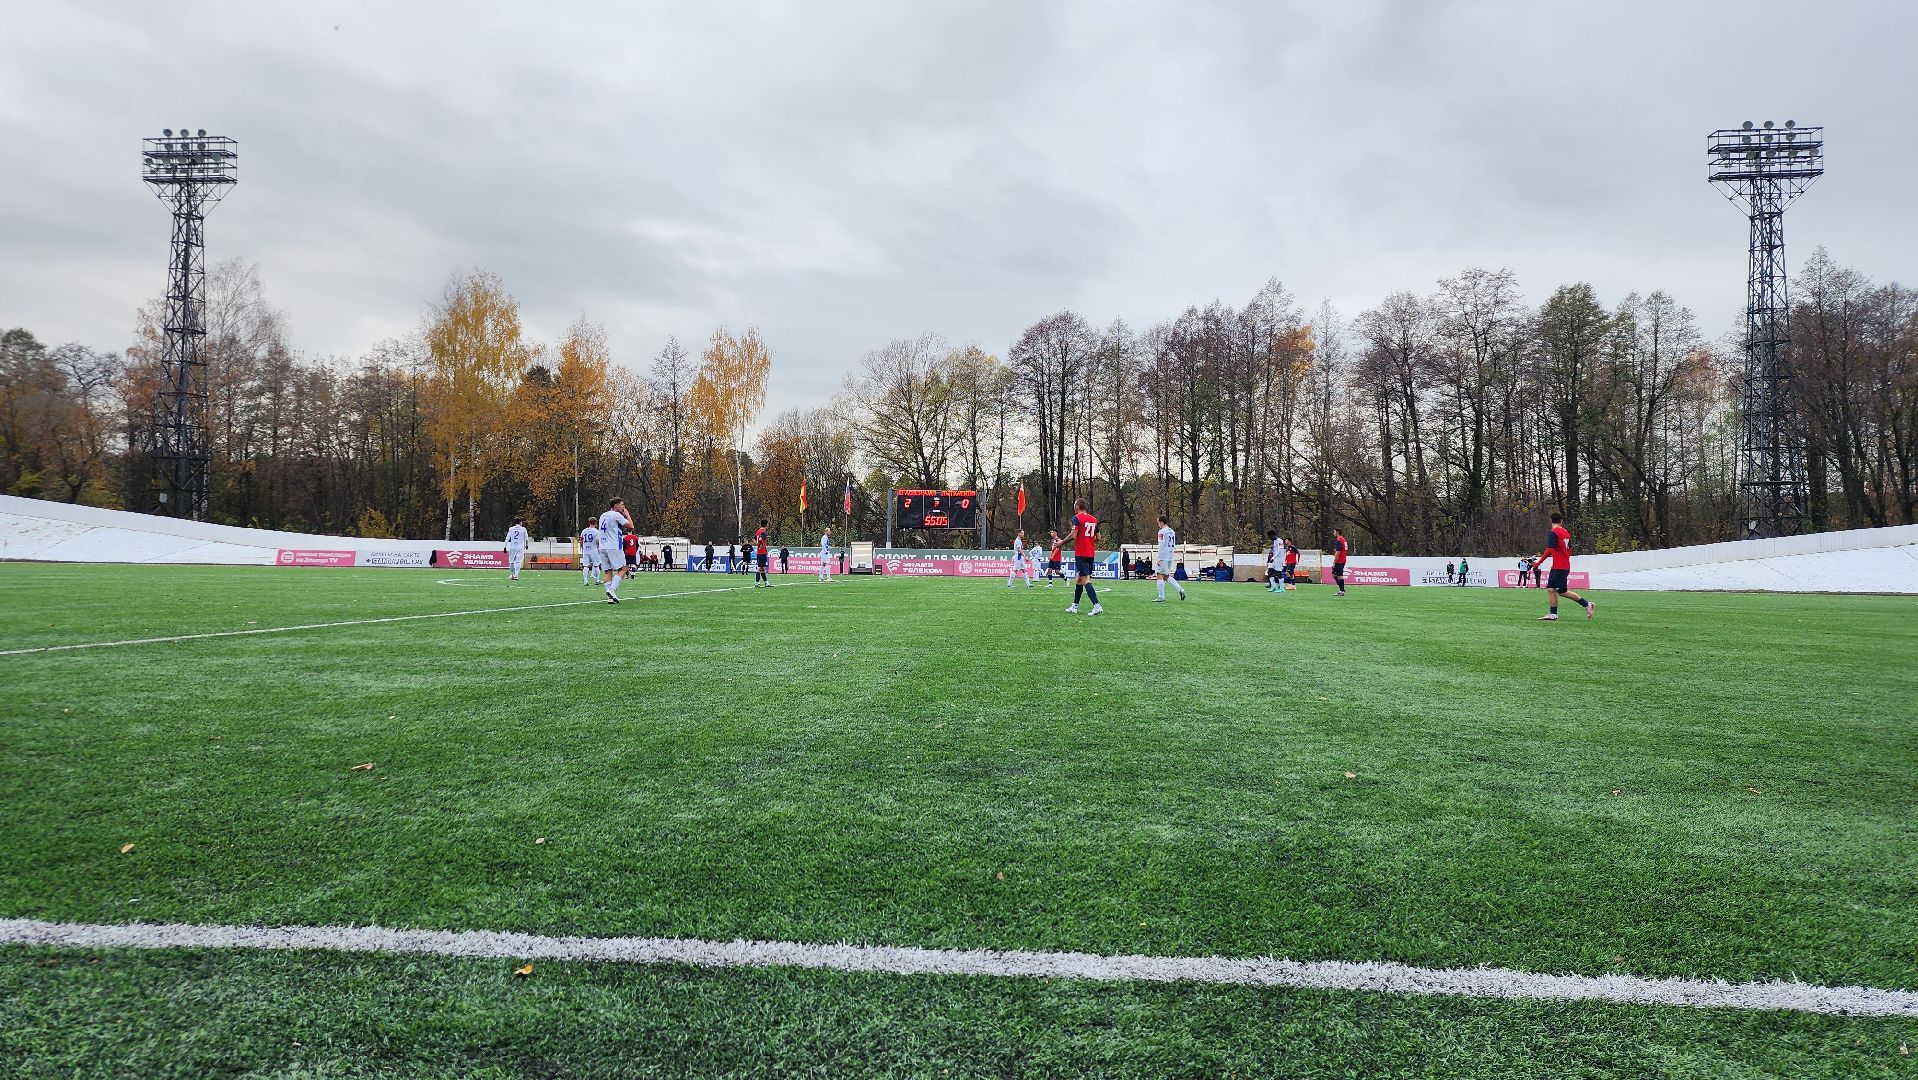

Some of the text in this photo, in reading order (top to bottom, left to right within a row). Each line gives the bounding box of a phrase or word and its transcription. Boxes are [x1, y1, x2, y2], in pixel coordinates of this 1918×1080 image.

[904, 498, 912, 508] 2
[961, 498, 970, 509] 0
[600, 519, 607, 533] 4
[1084, 521, 1096, 537] 27
[513, 530, 520, 540] 2
[583, 533, 594, 543] 19
